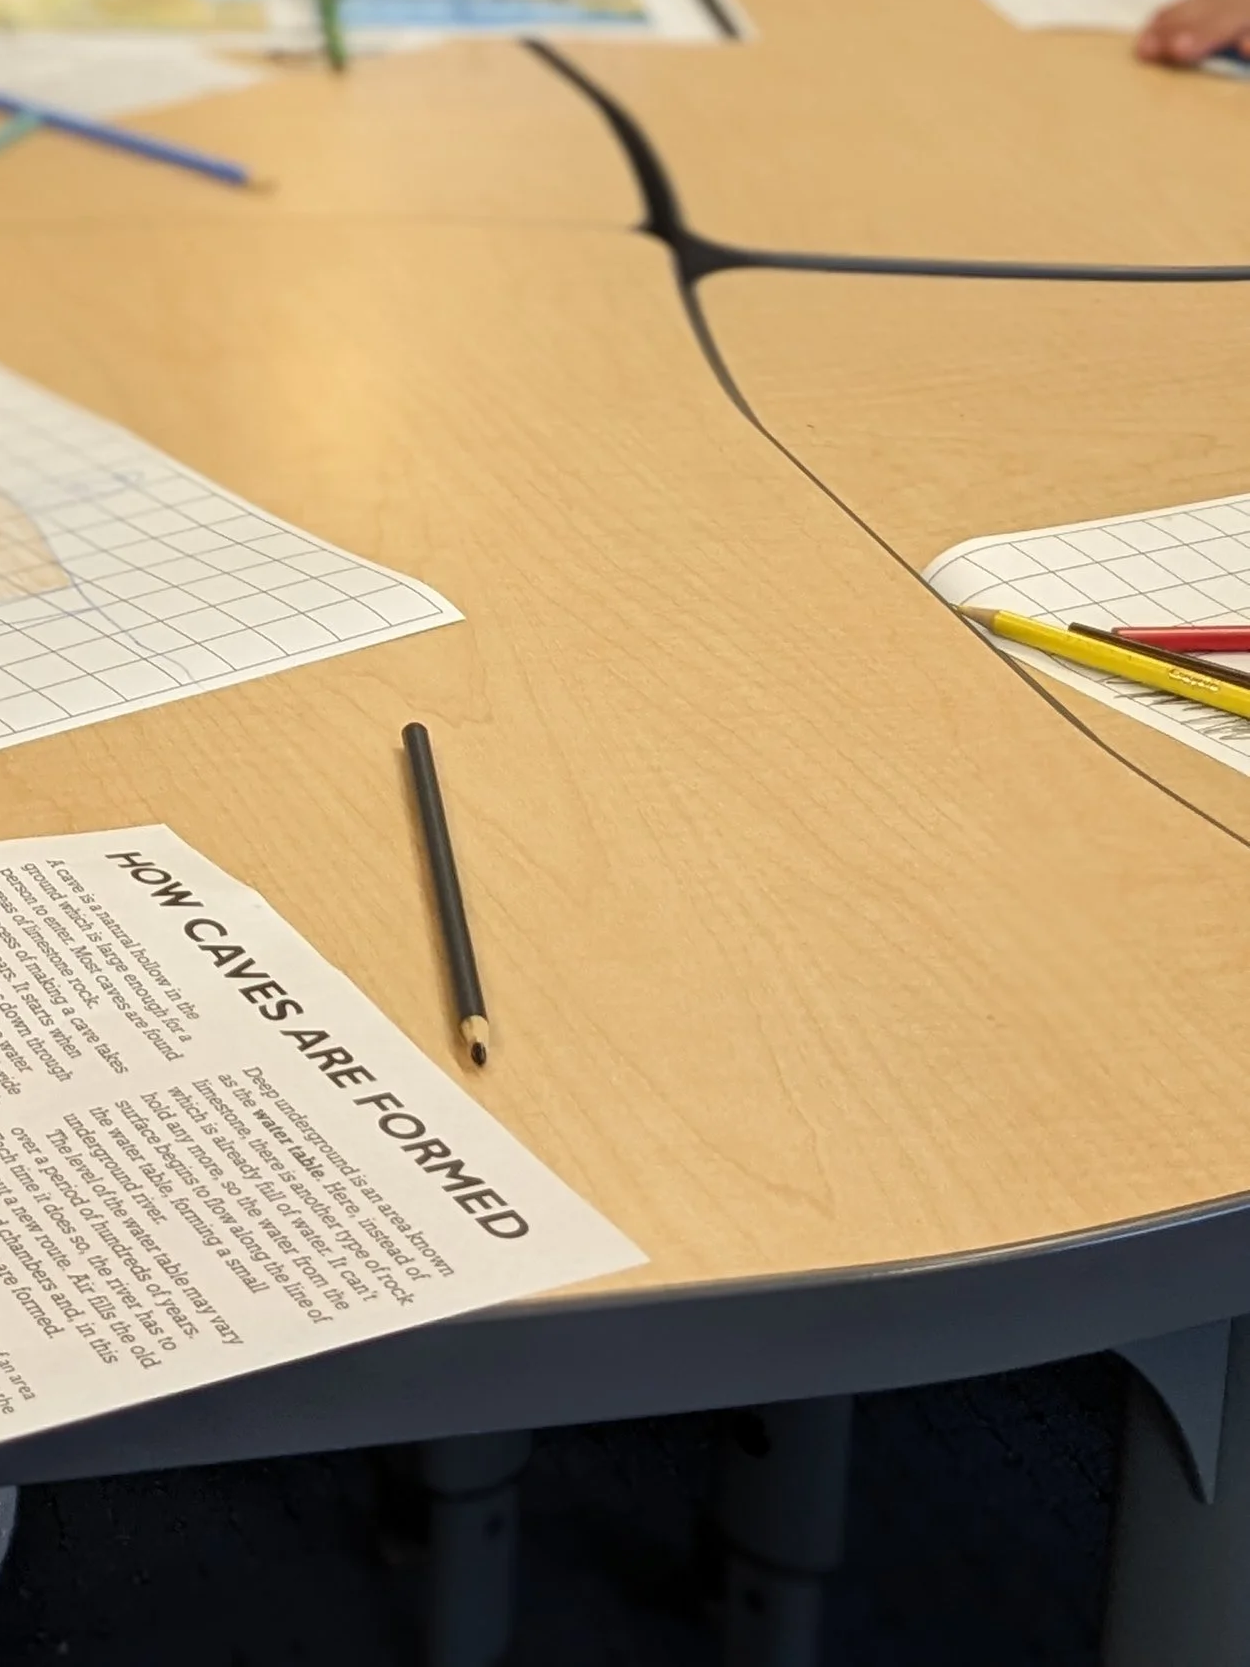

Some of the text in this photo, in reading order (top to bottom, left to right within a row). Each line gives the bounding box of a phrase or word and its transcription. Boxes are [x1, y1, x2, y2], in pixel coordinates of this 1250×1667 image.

[14, 949, 38, 963] of
[19, 862, 192, 1043] ground which is large enough for a
[45, 859, 200, 1020] A cave is a natural hollow in the
[11, 980, 30, 994] It
[24, 961, 69, 1005] making
[31, 904, 48, 916] to
[42, 916, 76, 946] enter.
[68, 944, 103, 974] Most
[94, 974, 131, 1011] caves
[124, 1010, 149, 1029] are
[141, 1028, 185, 1062] found
[20, 993, 55, 1027] starts
[61, 1006, 75, 1017] a
[48, 1027, 82, 1059] when
[69, 1017, 100, 1044] cave
[104, 851, 529, 1239] HOW CAVES ARE FORMED
[93, 1042, 129, 1074] takes
[62, 1112, 168, 1225] underground river.
[217, 1073, 432, 1281] as the water table. Here, instead of
[241, 1066, 455, 1277] Deep underground is an area known
[3, 1196, 18, 1207] a
[88, 1106, 270, 1294] the water table, forming a small
[139, 1091, 350, 1310] hold any more, so the water from the
[167, 1085, 378, 1302] which is already full of water. It can't
[10, 1205, 43, 1232] new
[10, 1127, 199, 1339] over a period of hundreds of years.
[33, 1233, 71, 1272] route.
[66, 1273, 96, 1294] Air
[10, 1286, 65, 1339] formed.
[86, 1295, 117, 1320] fills
[109, 1320, 136, 1344] the
[129, 1345, 162, 1370] old
[8, 1374, 36, 1401] area
